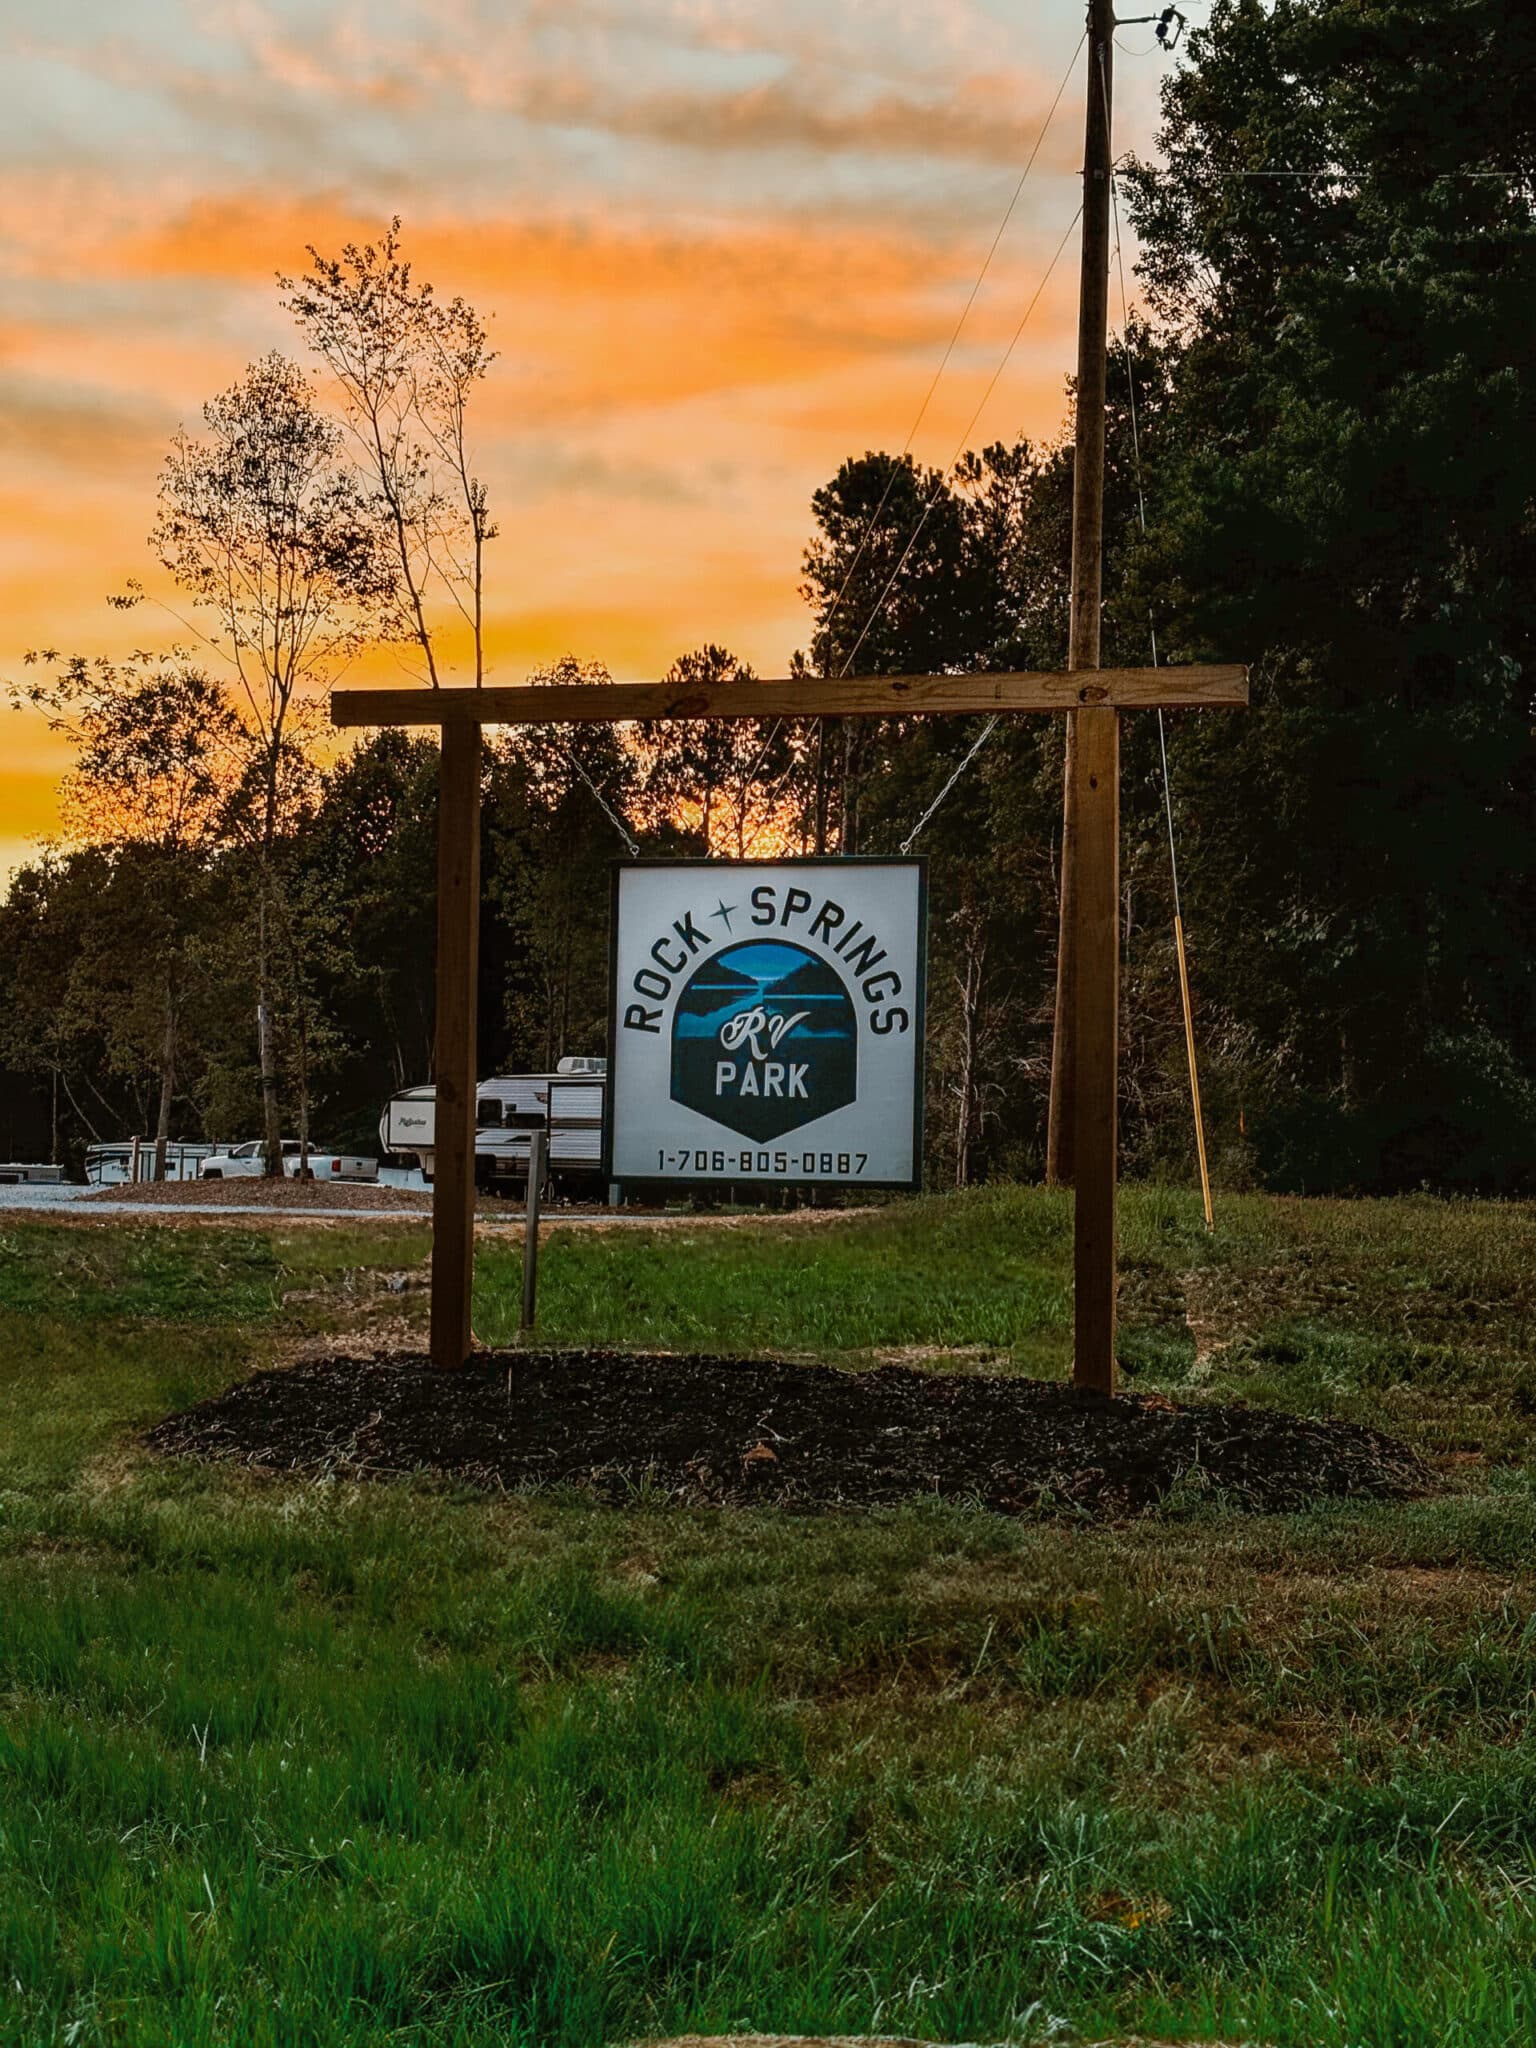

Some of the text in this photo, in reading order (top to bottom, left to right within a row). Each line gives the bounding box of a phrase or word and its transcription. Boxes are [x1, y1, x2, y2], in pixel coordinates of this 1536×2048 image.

[623, 886, 909, 1035] ROCK SPRINGS
[719, 1005, 811, 1060] RV
[715, 1061, 810, 1098] PARK
[658, 1149, 868, 1175] 1-706-805-0887
